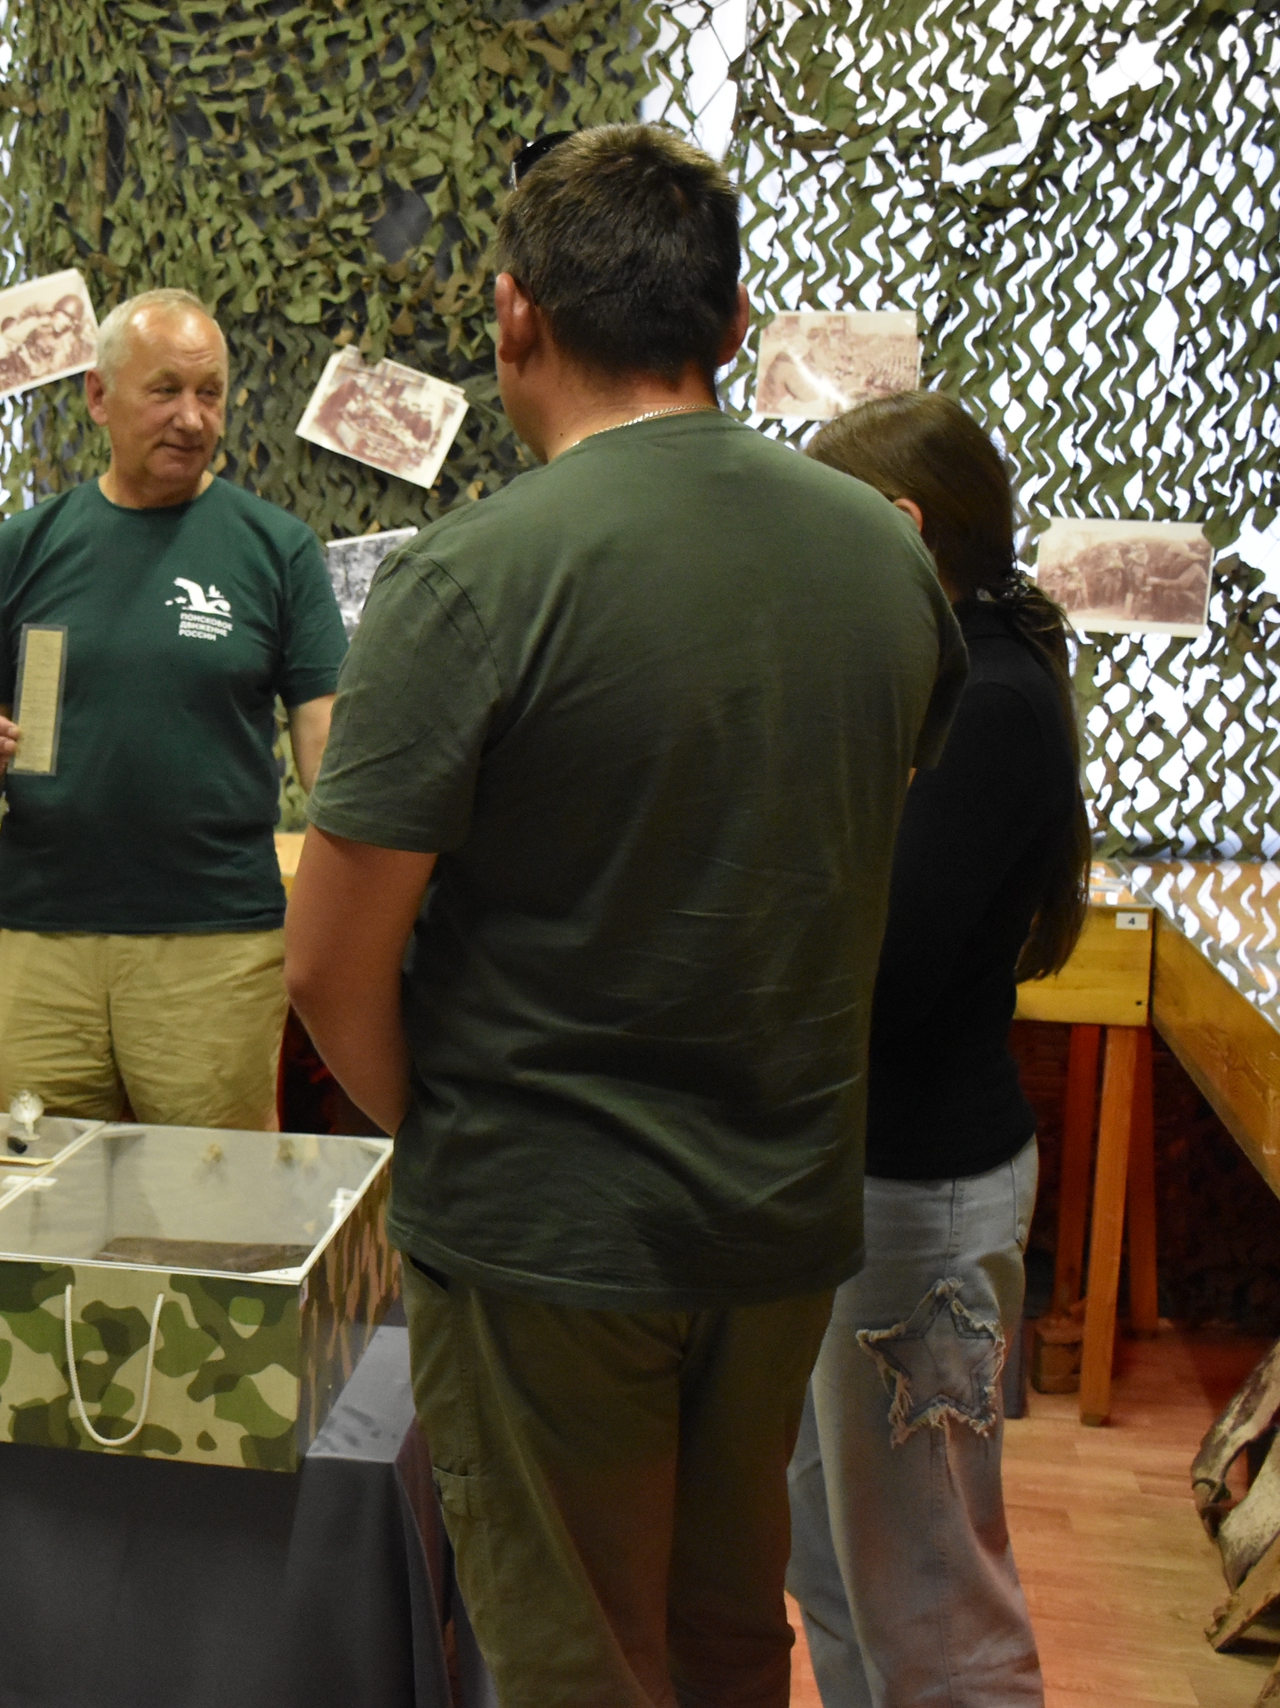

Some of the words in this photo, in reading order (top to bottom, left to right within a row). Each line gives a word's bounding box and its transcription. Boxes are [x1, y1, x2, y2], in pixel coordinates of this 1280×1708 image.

[179, 620, 228, 637] ДВИЖЕНИЕ
[180, 613, 233, 631] ПОИСКОВОЕ
[179, 629, 216, 641] РОССИИ
[1128, 917, 1135, 925] 4
